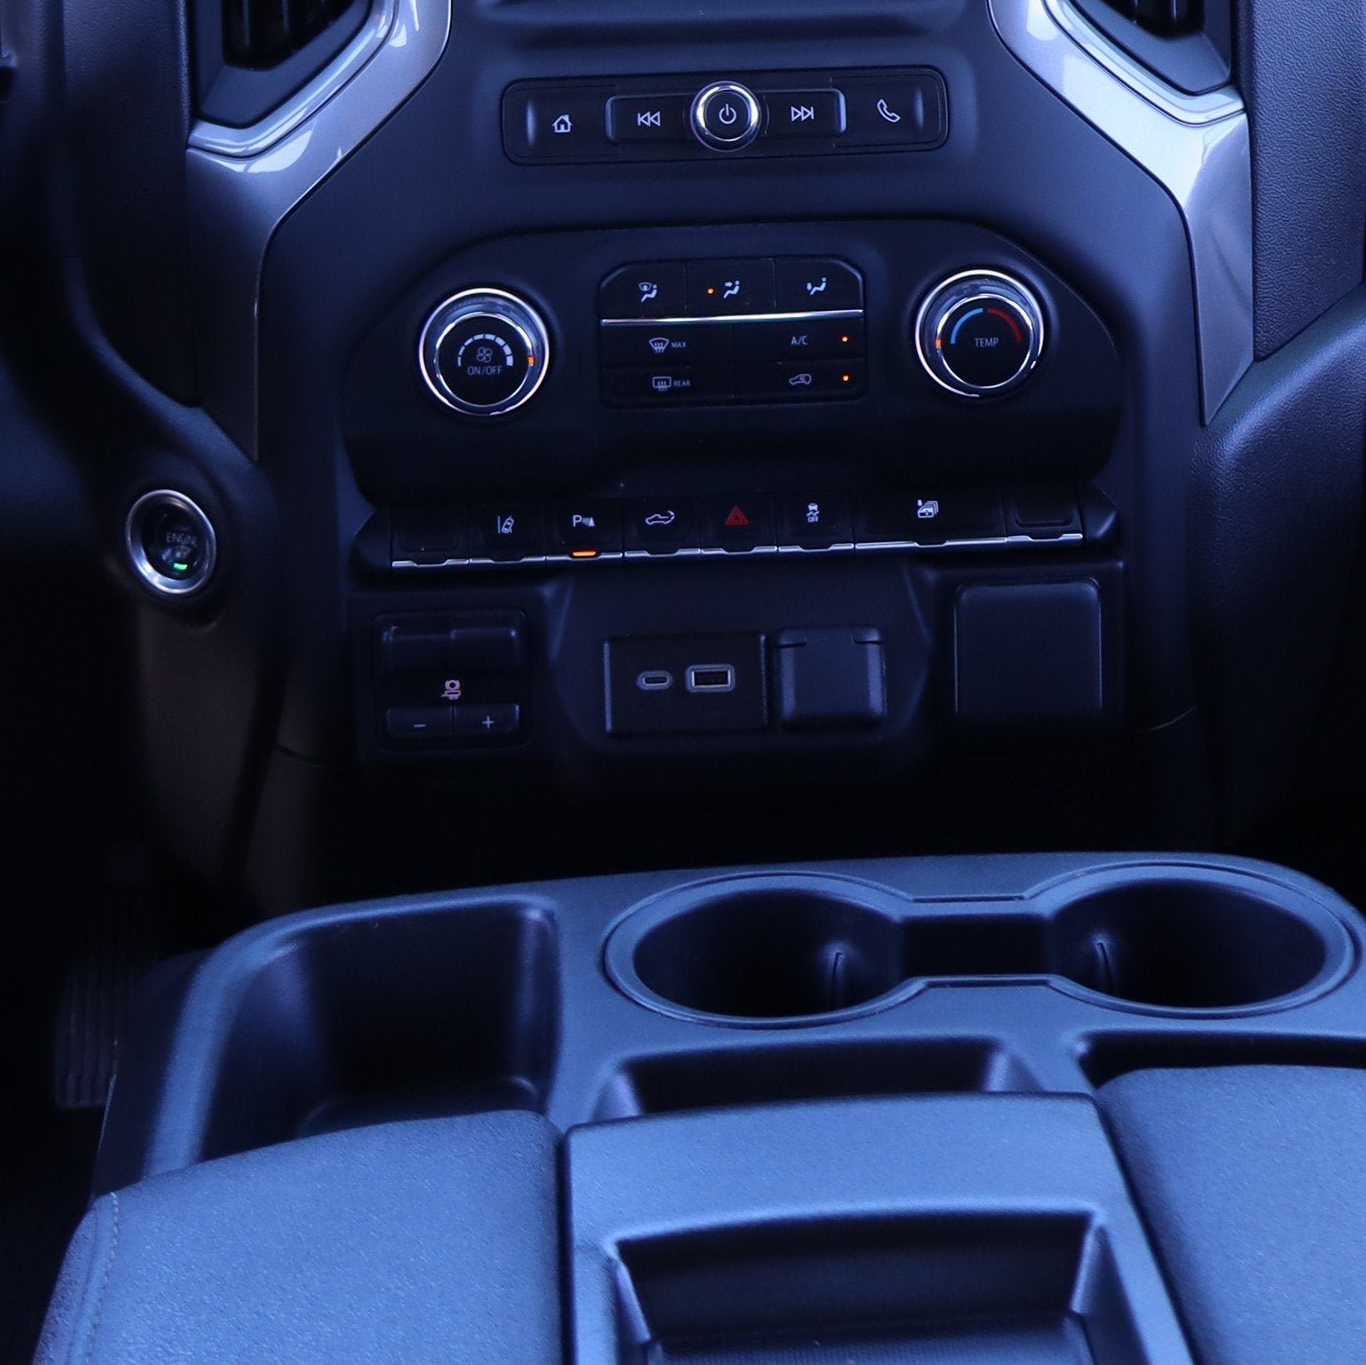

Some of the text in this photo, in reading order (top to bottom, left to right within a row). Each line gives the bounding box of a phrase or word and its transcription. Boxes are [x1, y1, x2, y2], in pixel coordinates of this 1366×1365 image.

[791, 335, 808, 346] A/C
[974, 337, 999, 348] TEMP
[467, 365, 503, 376] ON/OFF
